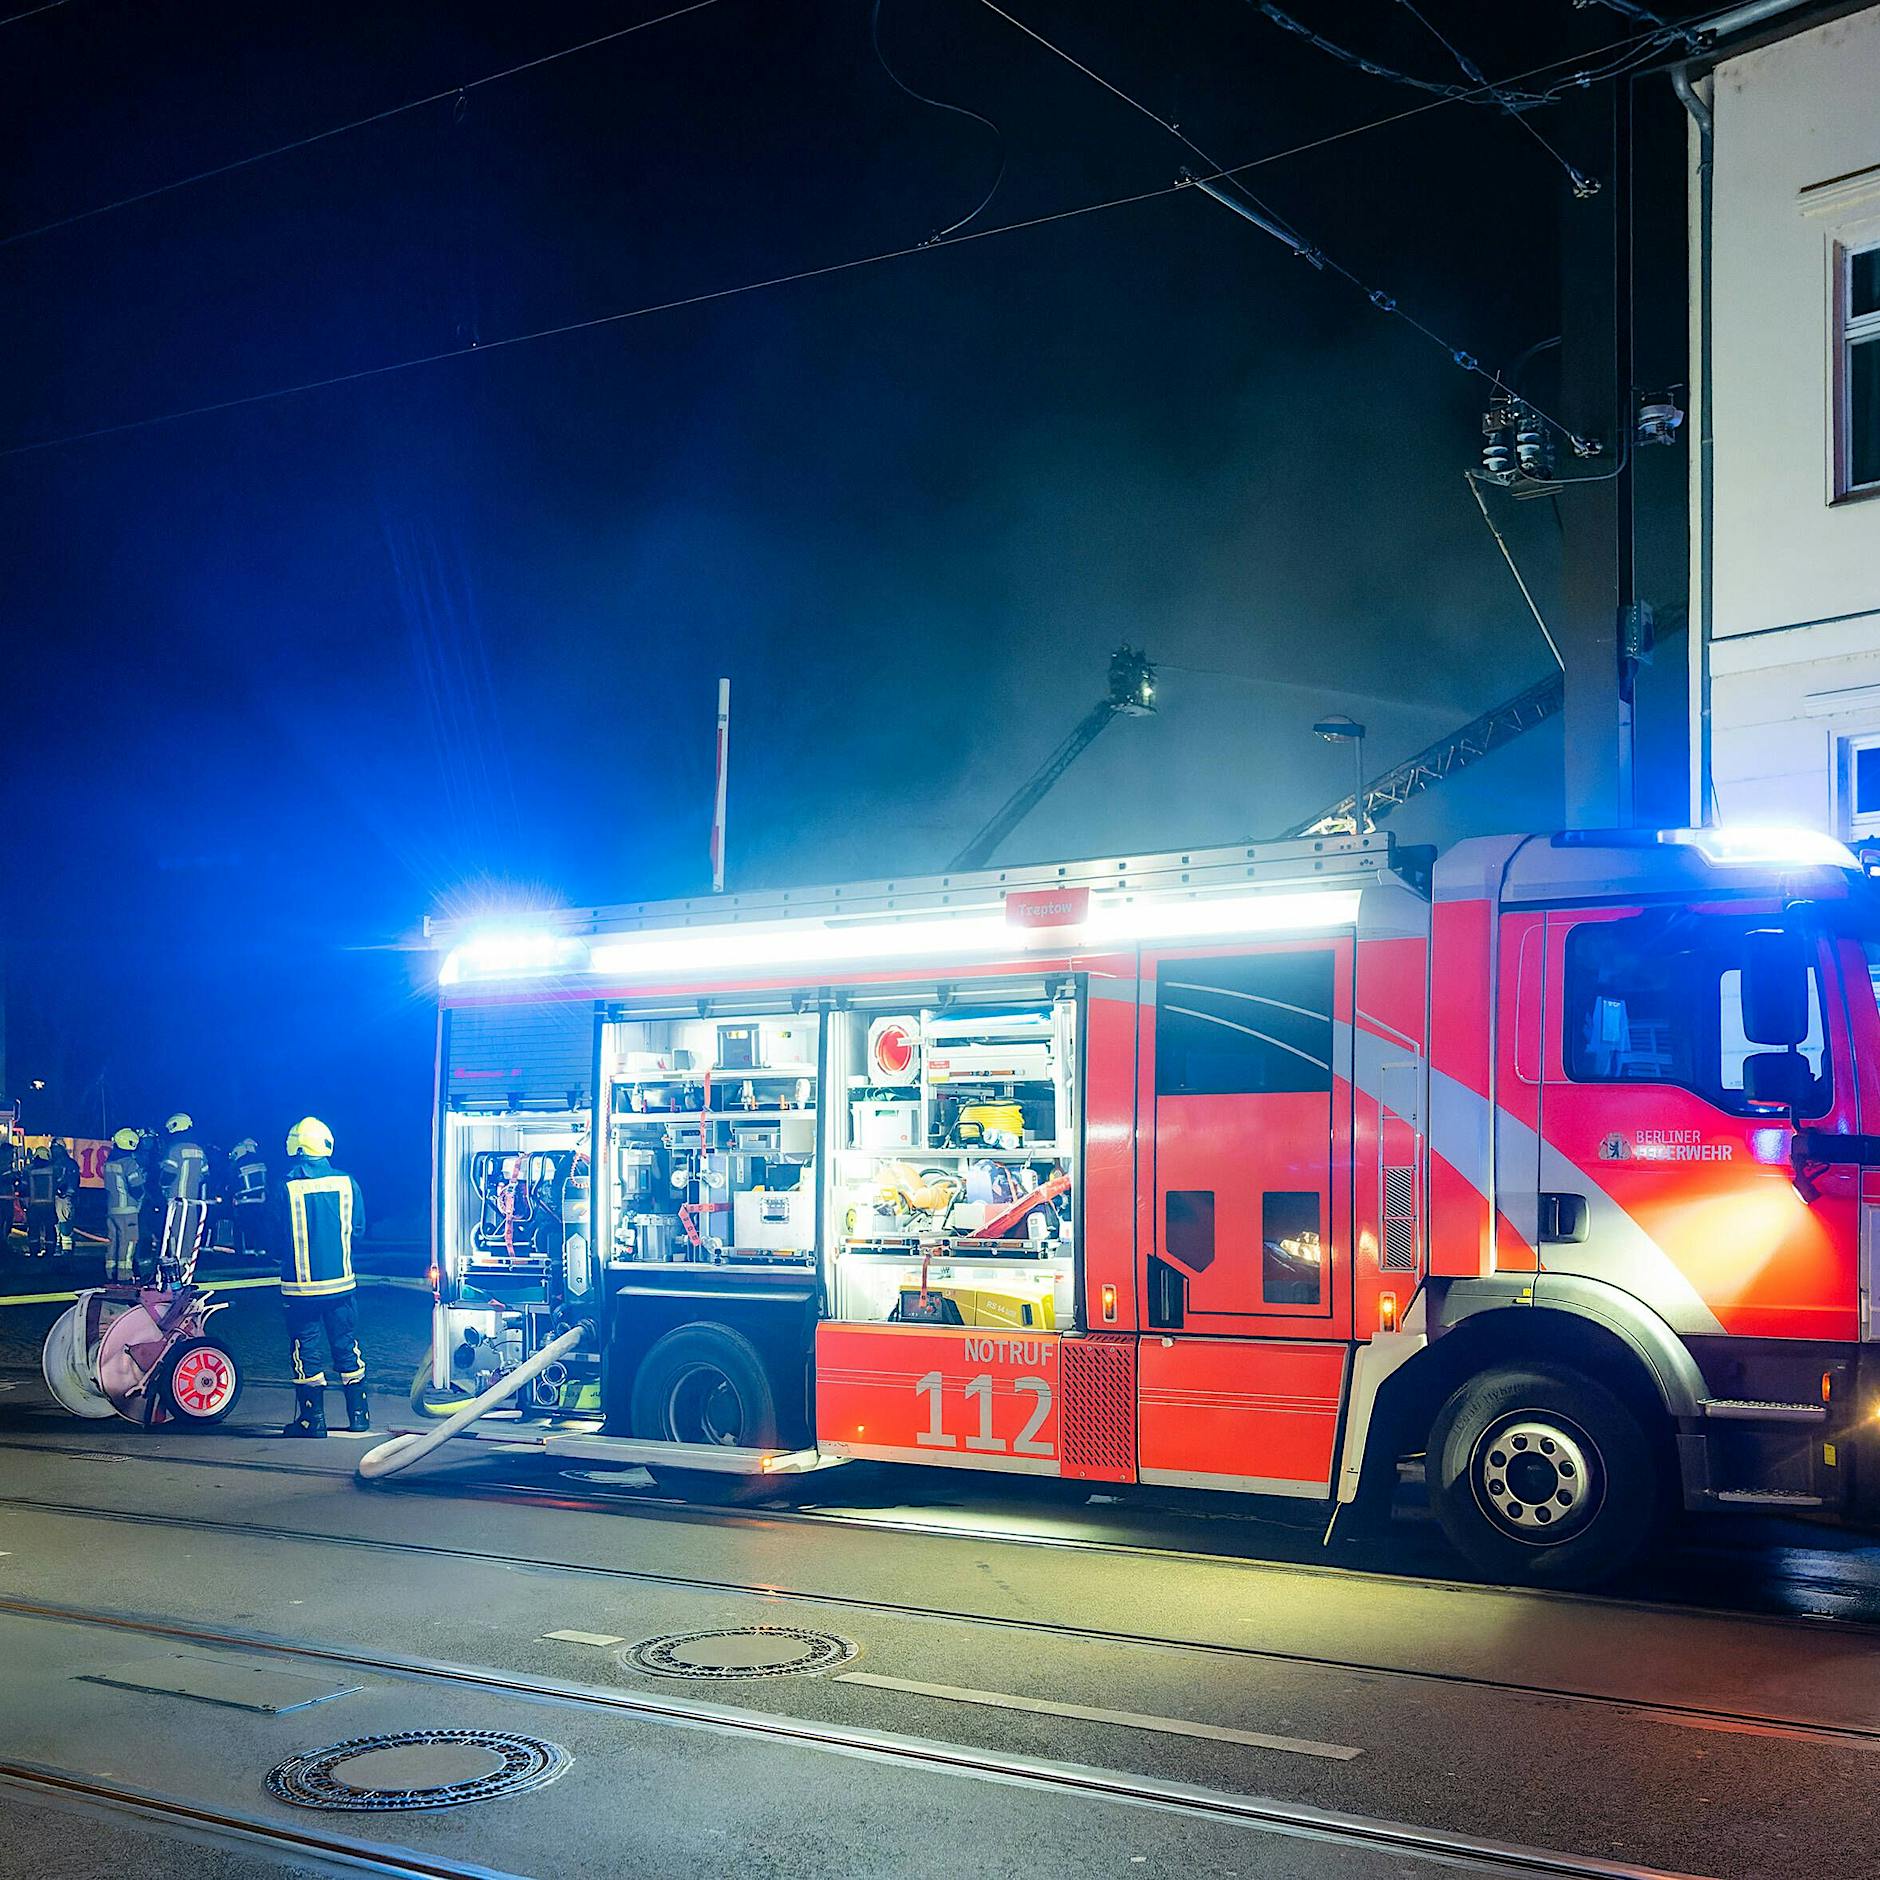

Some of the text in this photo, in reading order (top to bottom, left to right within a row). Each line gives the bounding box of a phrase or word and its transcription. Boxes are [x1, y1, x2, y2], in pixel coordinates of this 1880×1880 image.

[1017, 902, 1073, 918] Treptow
[1636, 1130, 1701, 1144] BERLINER
[1636, 1145, 1733, 1161] FEUERWEHR
[964, 1338, 1054, 1367] NOTRUF
[916, 1371, 1056, 1456] 112
